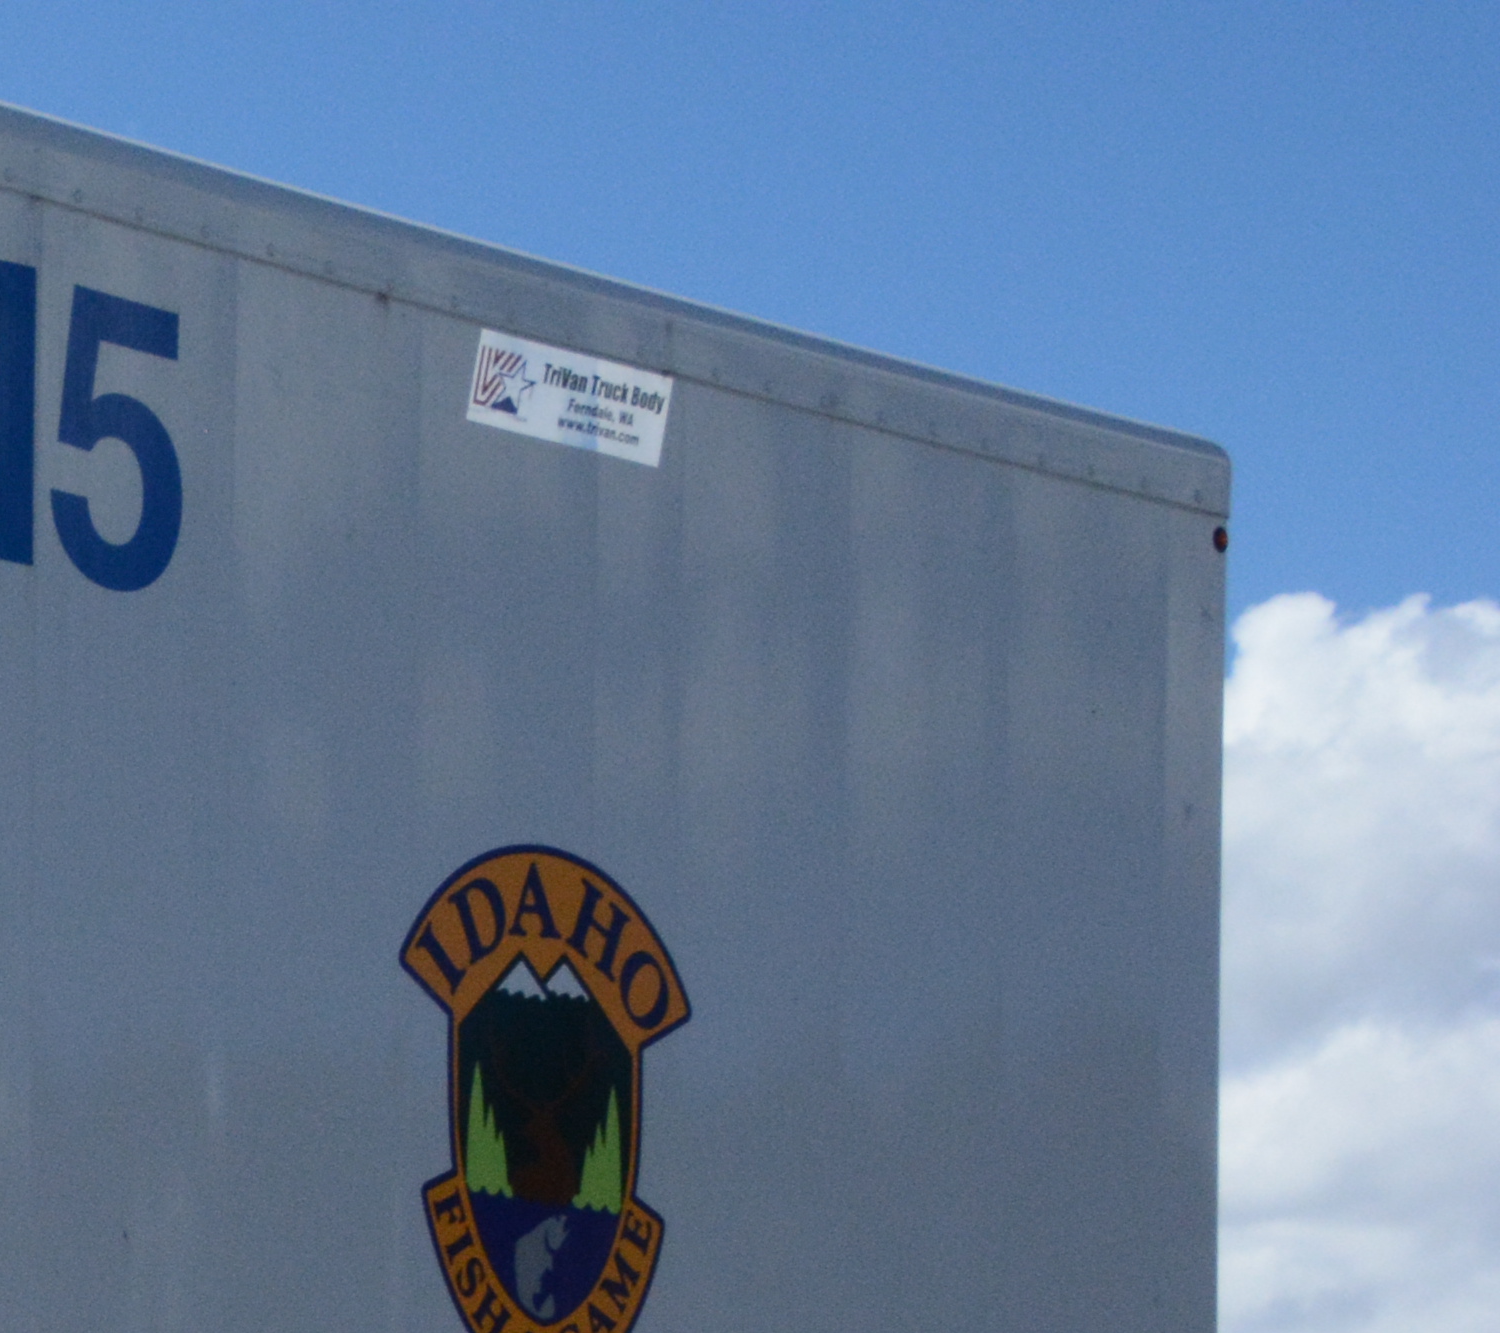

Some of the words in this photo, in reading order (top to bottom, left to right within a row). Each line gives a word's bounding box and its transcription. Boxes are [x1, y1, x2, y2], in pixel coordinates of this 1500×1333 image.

[543, 363, 589, 393] TriVan
[591, 374, 628, 403] Truck
[631, 386, 666, 416] Body
[557, 417, 640, 446] www.trivan.com
[619, 411, 635, 426] WA
[415, 861, 671, 1031] IDAHO
